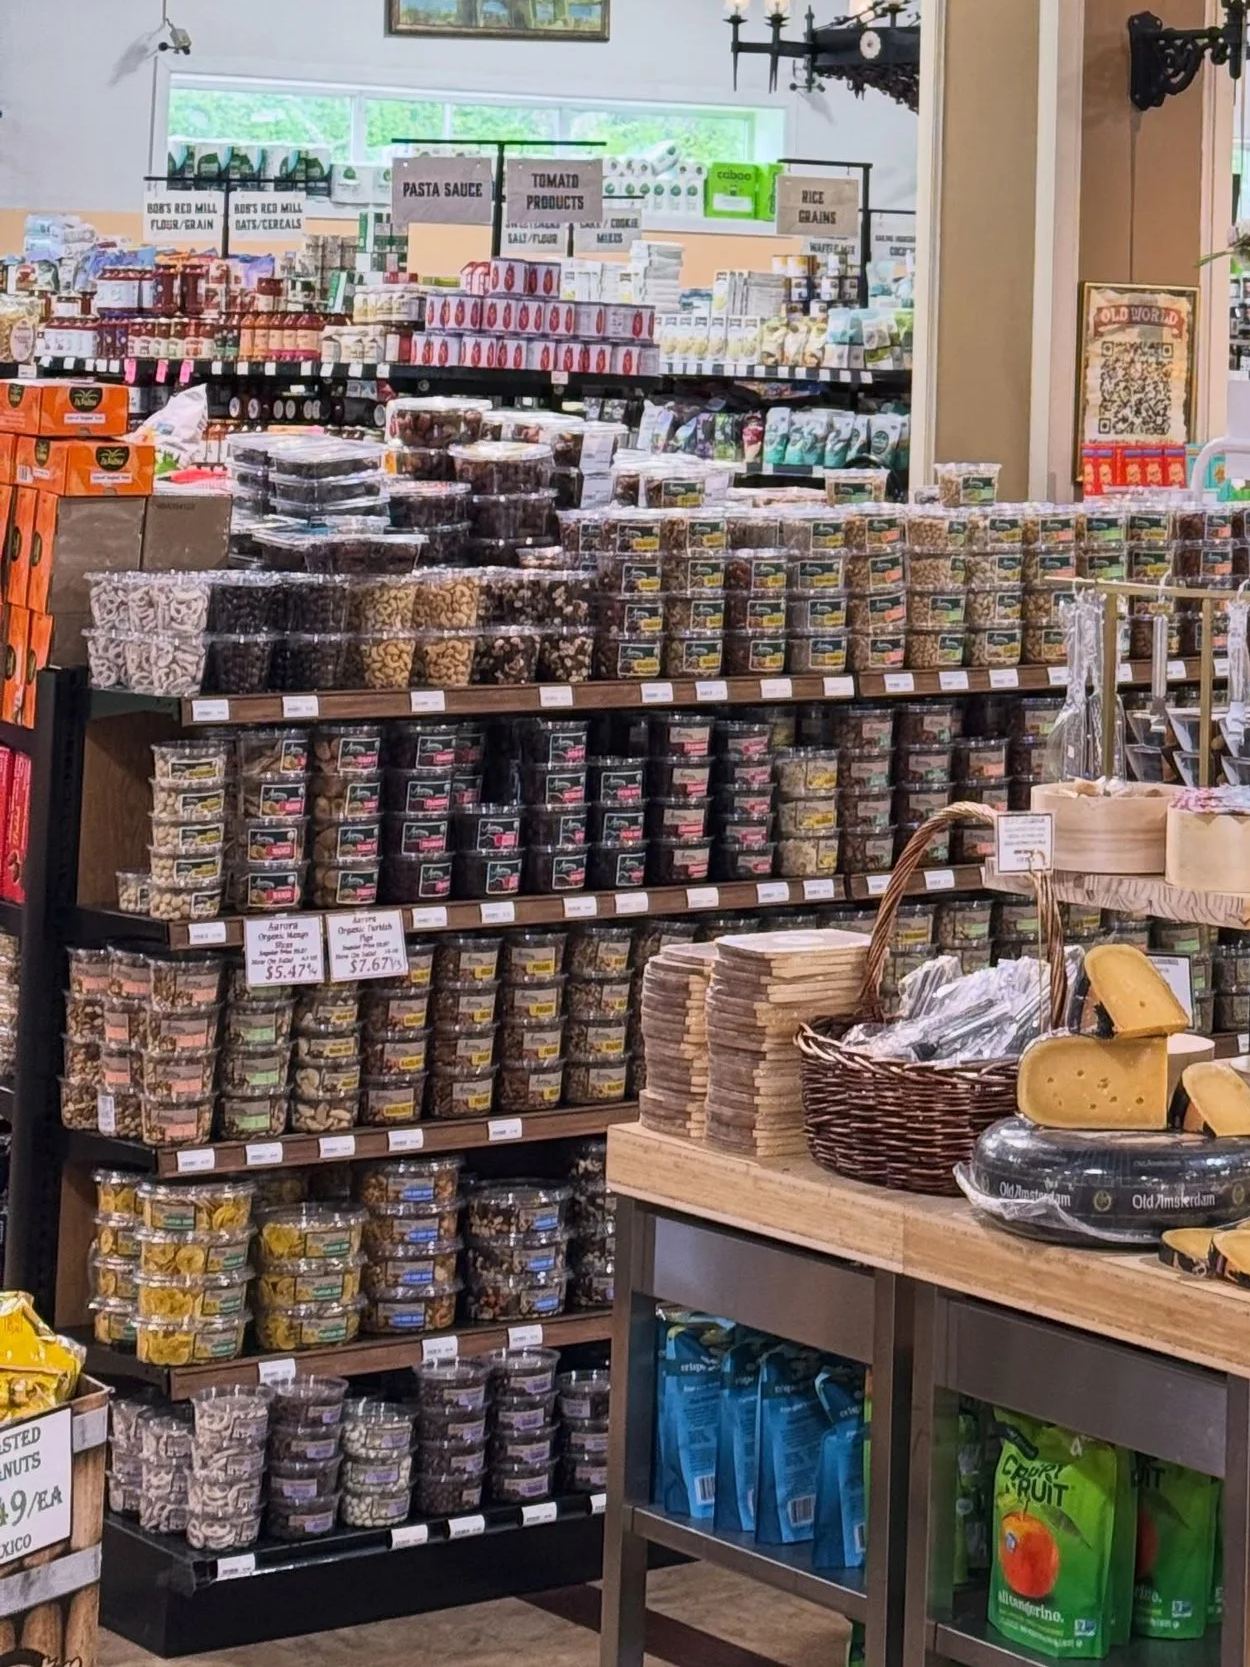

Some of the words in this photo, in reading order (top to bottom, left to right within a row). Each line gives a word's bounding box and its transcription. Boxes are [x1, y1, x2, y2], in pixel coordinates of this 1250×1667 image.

[532, 173, 579, 189] TOMATO
[717, 170, 752, 182] caboo
[402, 183, 440, 198] PASTA
[444, 183, 483, 198] SAUCE
[801, 190, 825, 204] RICE
[147, 203, 171, 214] BOB'S
[174, 203, 191, 214] RED
[195, 203, 217, 214] MILL
[234, 203, 258, 214] BOB'S
[261, 203, 278, 214] RED
[281, 203, 303, 214] MILL
[526, 195, 584, 211] PRODUCTS
[798, 210, 836, 225] GRAINS
[1100, 306, 1129, 322] OLD
[1130, 307, 1180, 326] WORLD
[265, 963, 306, 981] $5.47
[350, 958, 388, 974] $7.67
[1000, 1181, 1014, 1197] Old
[1131, 1193, 1153, 1210] Old
[1153, 1192, 1216, 1210] Amsterdam
[0, 1533, 32, 1560] XICO
